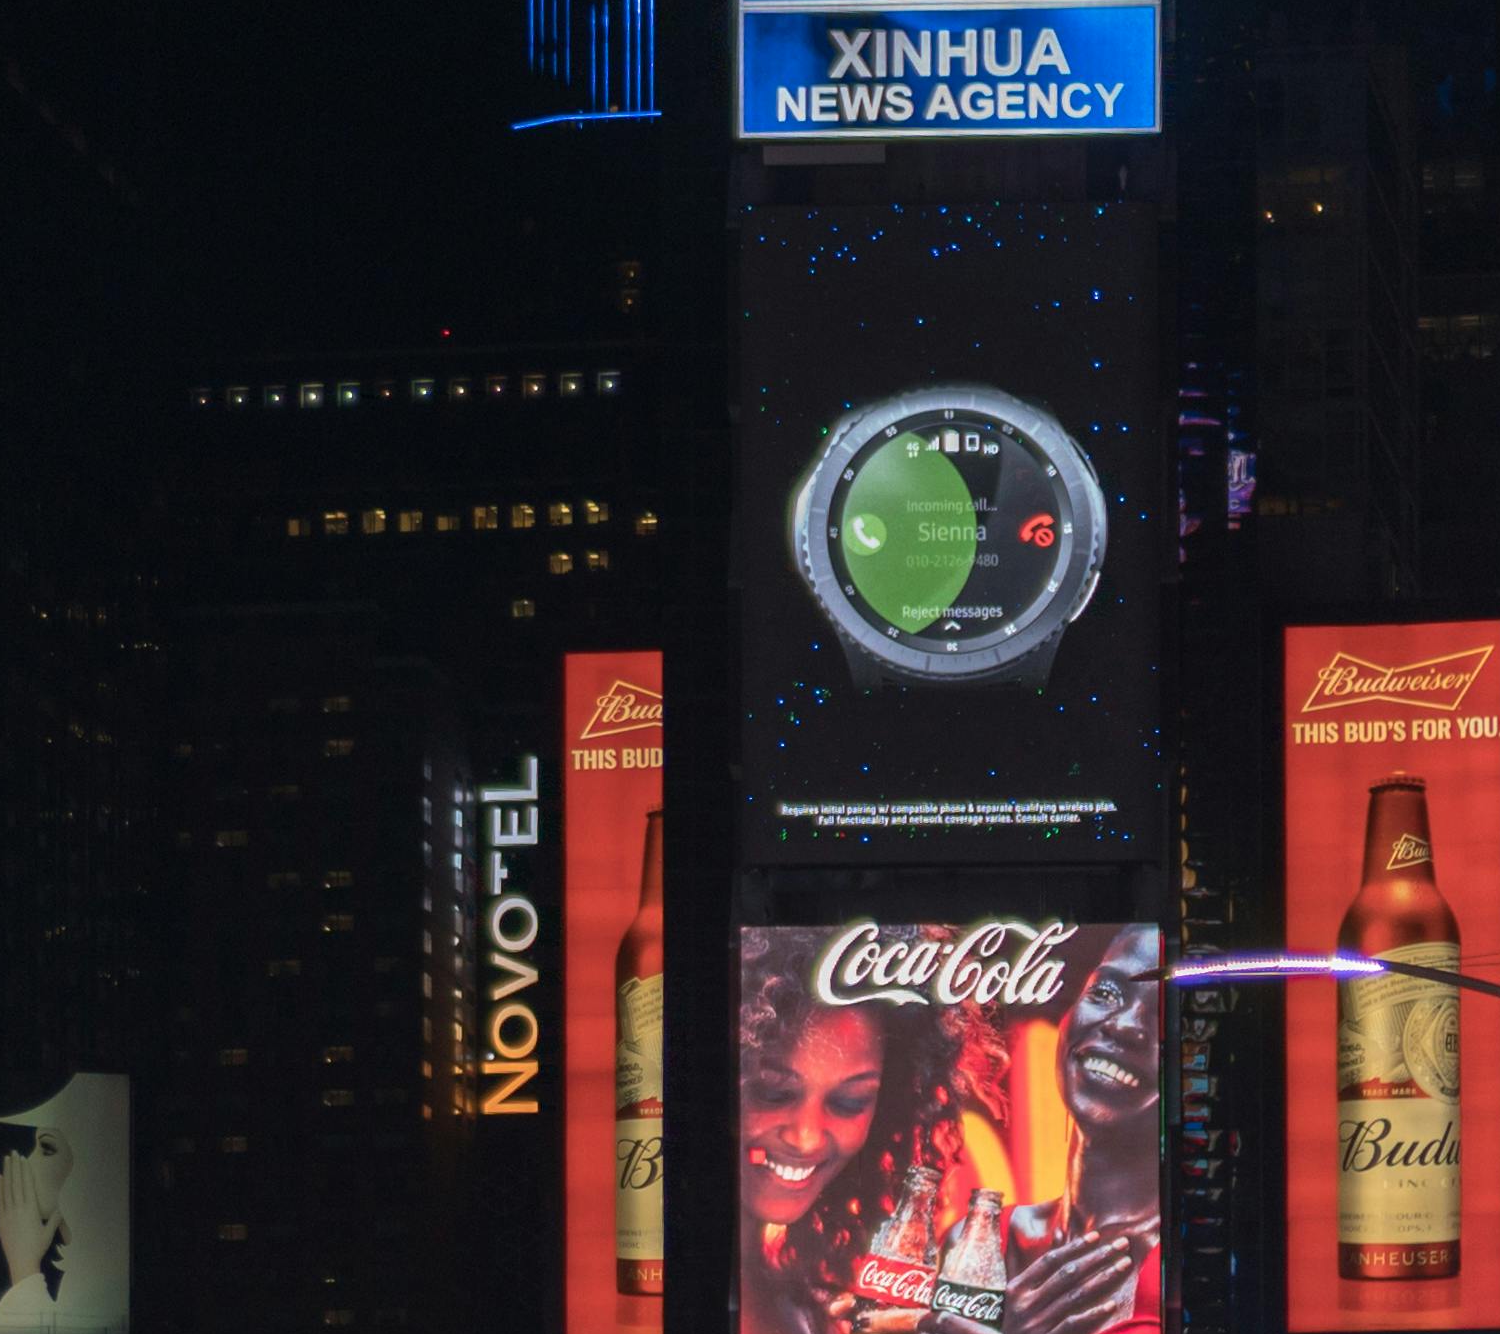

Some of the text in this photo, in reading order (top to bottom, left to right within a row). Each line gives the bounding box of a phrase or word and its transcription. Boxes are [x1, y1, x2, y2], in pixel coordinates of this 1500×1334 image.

[828, 27, 1070, 78] XINHUA
[777, 82, 1125, 121] NEWS AGENCY
[983, 446, 999, 456] HD
[905, 500, 963, 514] Incoming
[917, 523, 988, 542] Sienna
[901, 606, 1003, 620] Reject messages
[1321, 663, 1471, 697] Budweiser
[1292, 722, 1339, 744] THIS
[1343, 720, 1406, 742] BUD'S
[1413, 718, 1453, 740] FOR
[571, 748, 663, 773] THIS BUD
[483, 757, 539, 1115] NOVOTEL
[816, 922, 1079, 1006] Coca-Cola
